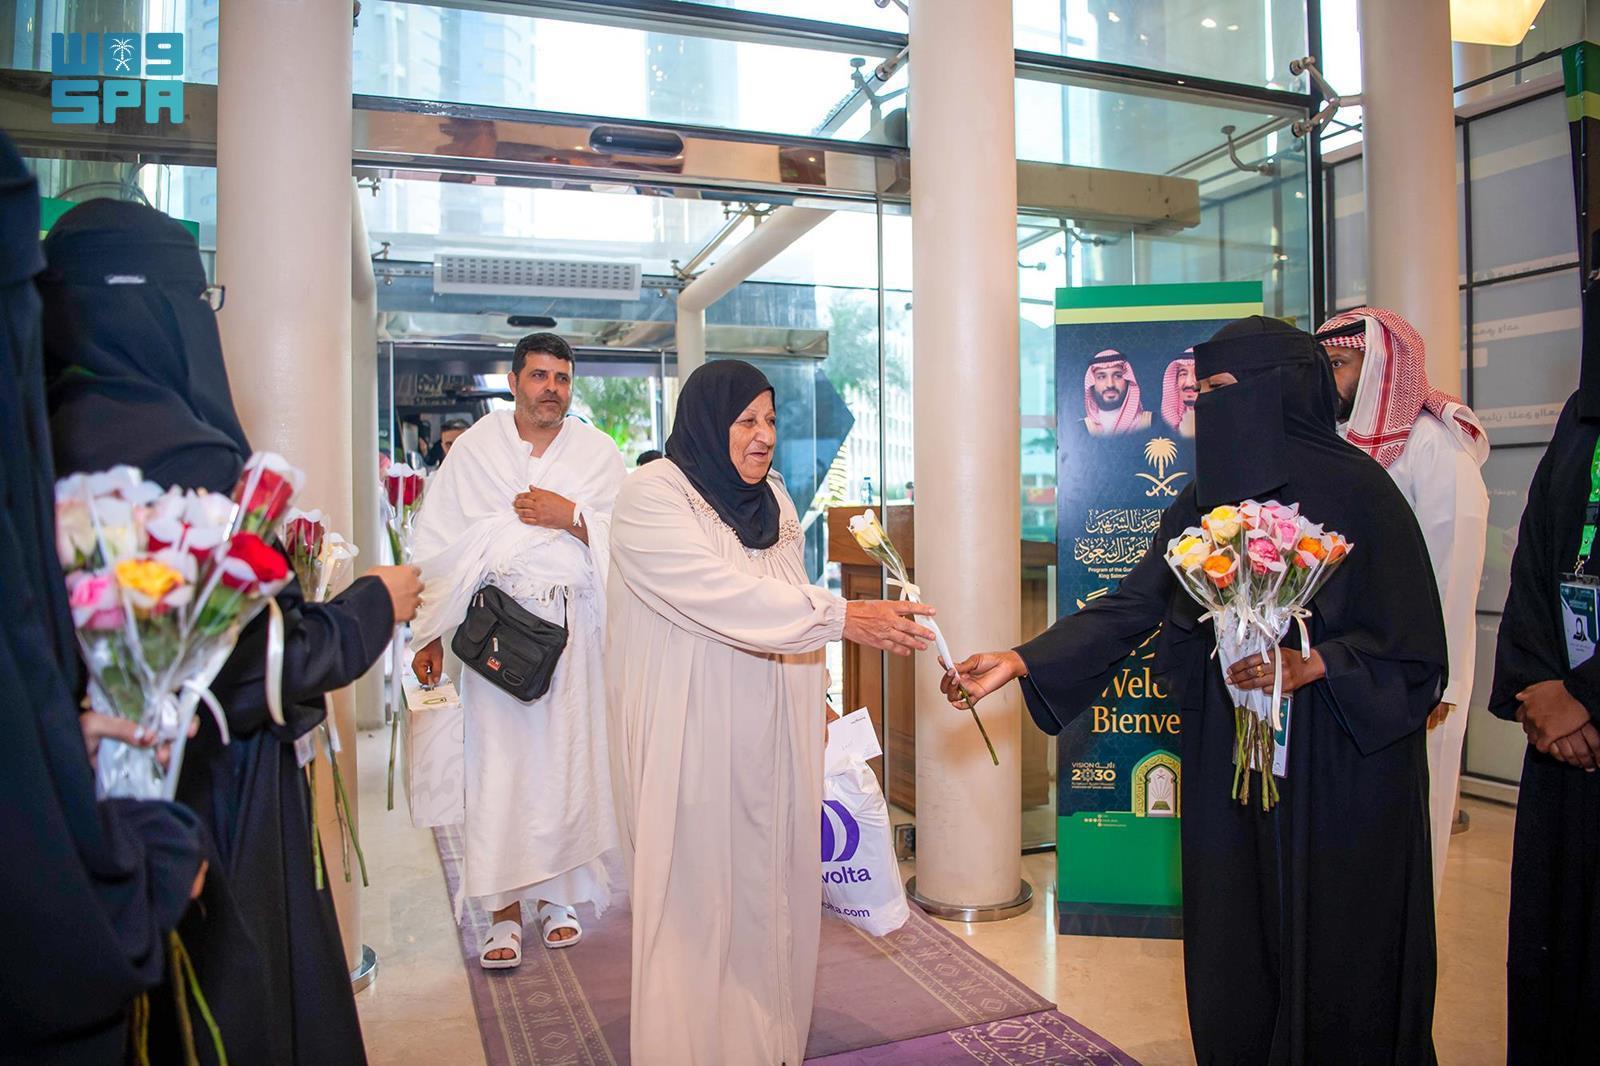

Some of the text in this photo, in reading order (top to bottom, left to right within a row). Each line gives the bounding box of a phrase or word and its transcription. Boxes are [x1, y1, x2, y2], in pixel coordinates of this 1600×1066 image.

[1091, 705, 1181, 734] Bienve
[1071, 769, 1117, 782] 2030
[821, 866, 872, 884] volta
[821, 900, 870, 918] olta.com
